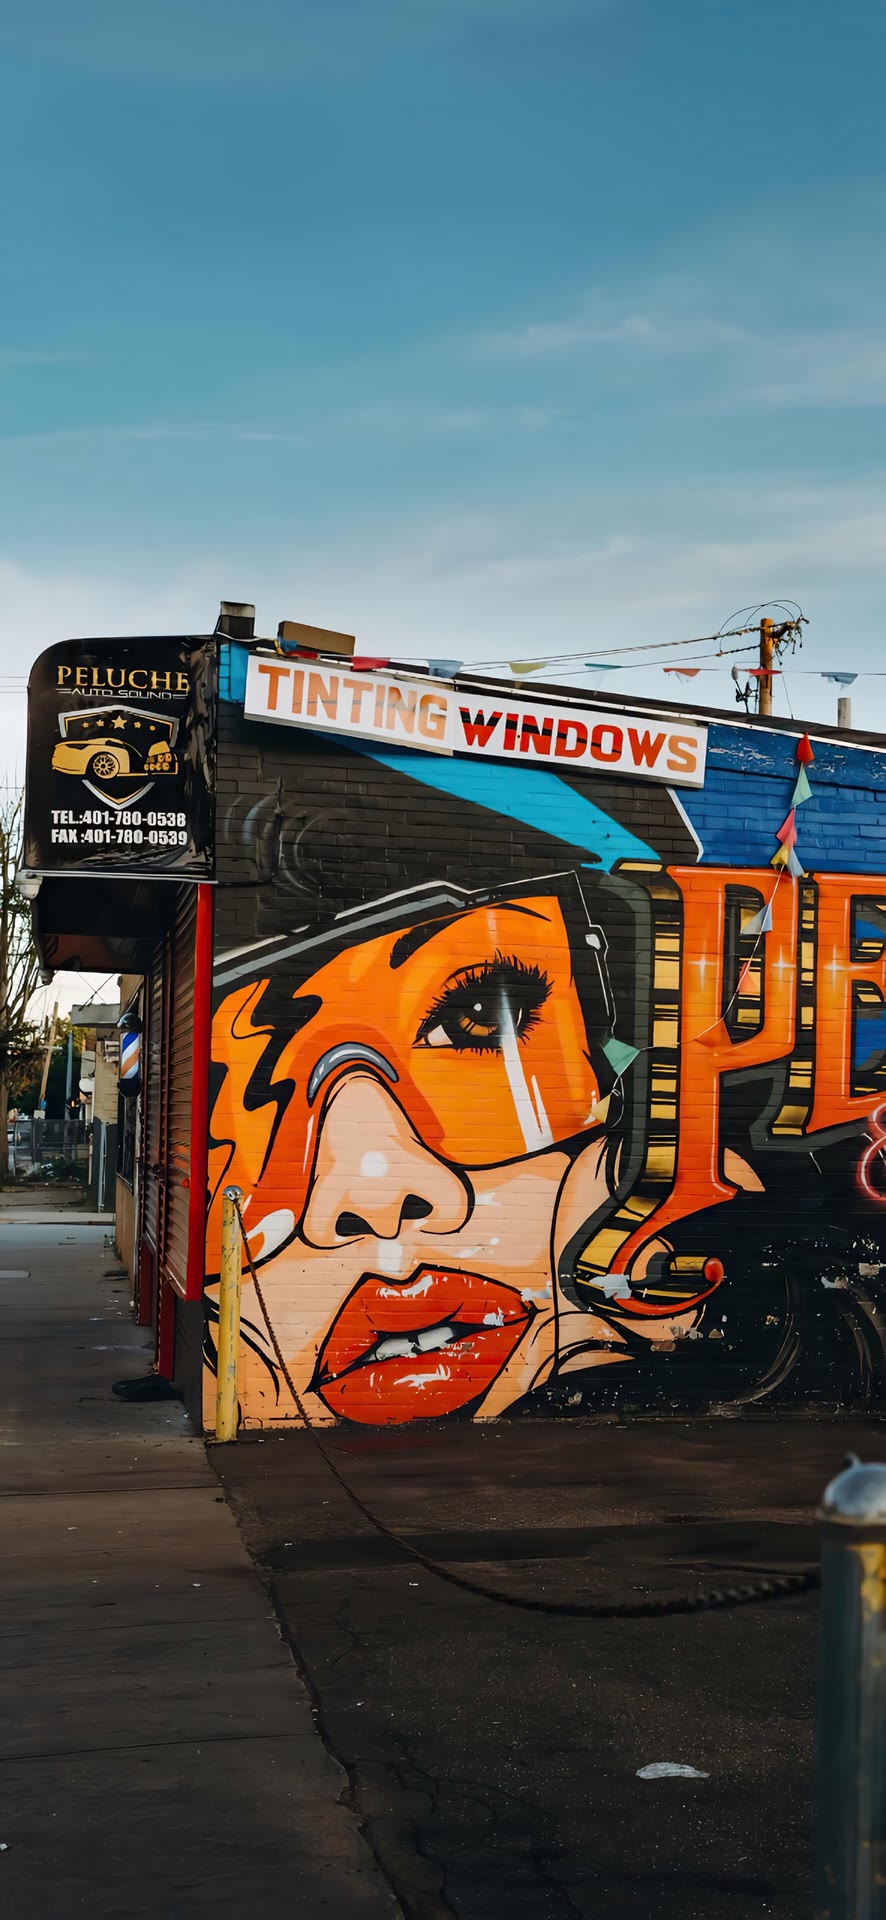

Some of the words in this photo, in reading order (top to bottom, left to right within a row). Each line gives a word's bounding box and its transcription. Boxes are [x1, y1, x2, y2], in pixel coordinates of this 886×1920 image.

[57, 665, 190, 691] PELUCHE
[71, 688, 113, 697] AUTO
[118, 690, 172, 700] SOUND
[258, 664, 448, 740] TINTING
[459, 706, 698, 773] WINDOWS
